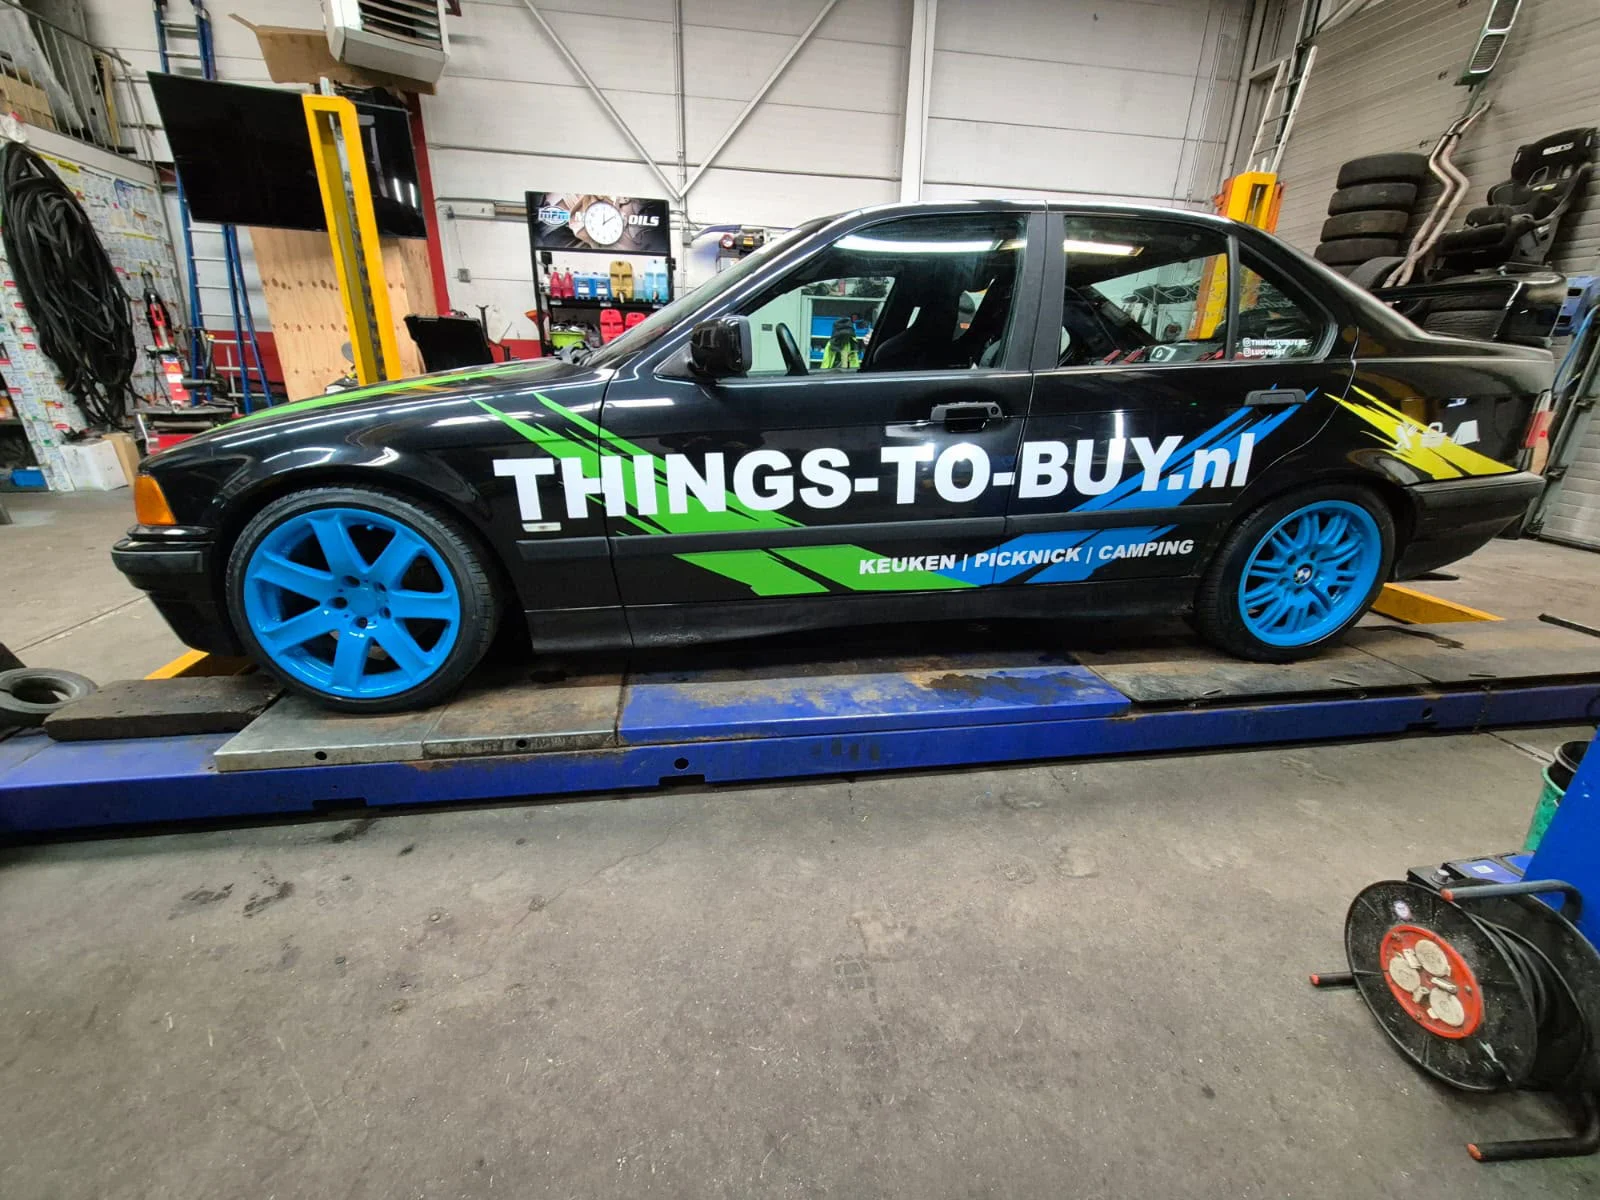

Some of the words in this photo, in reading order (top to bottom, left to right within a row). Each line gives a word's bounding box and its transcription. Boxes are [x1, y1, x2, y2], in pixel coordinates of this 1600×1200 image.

[628, 214, 660, 226] OILS
[492, 432, 1256, 521] THINGS-TO-BUY.nl
[859, 554, 956, 575] KEUKEN
[974, 548, 1081, 567] PICKNICK
[1098, 540, 1195, 560] CAMPING
